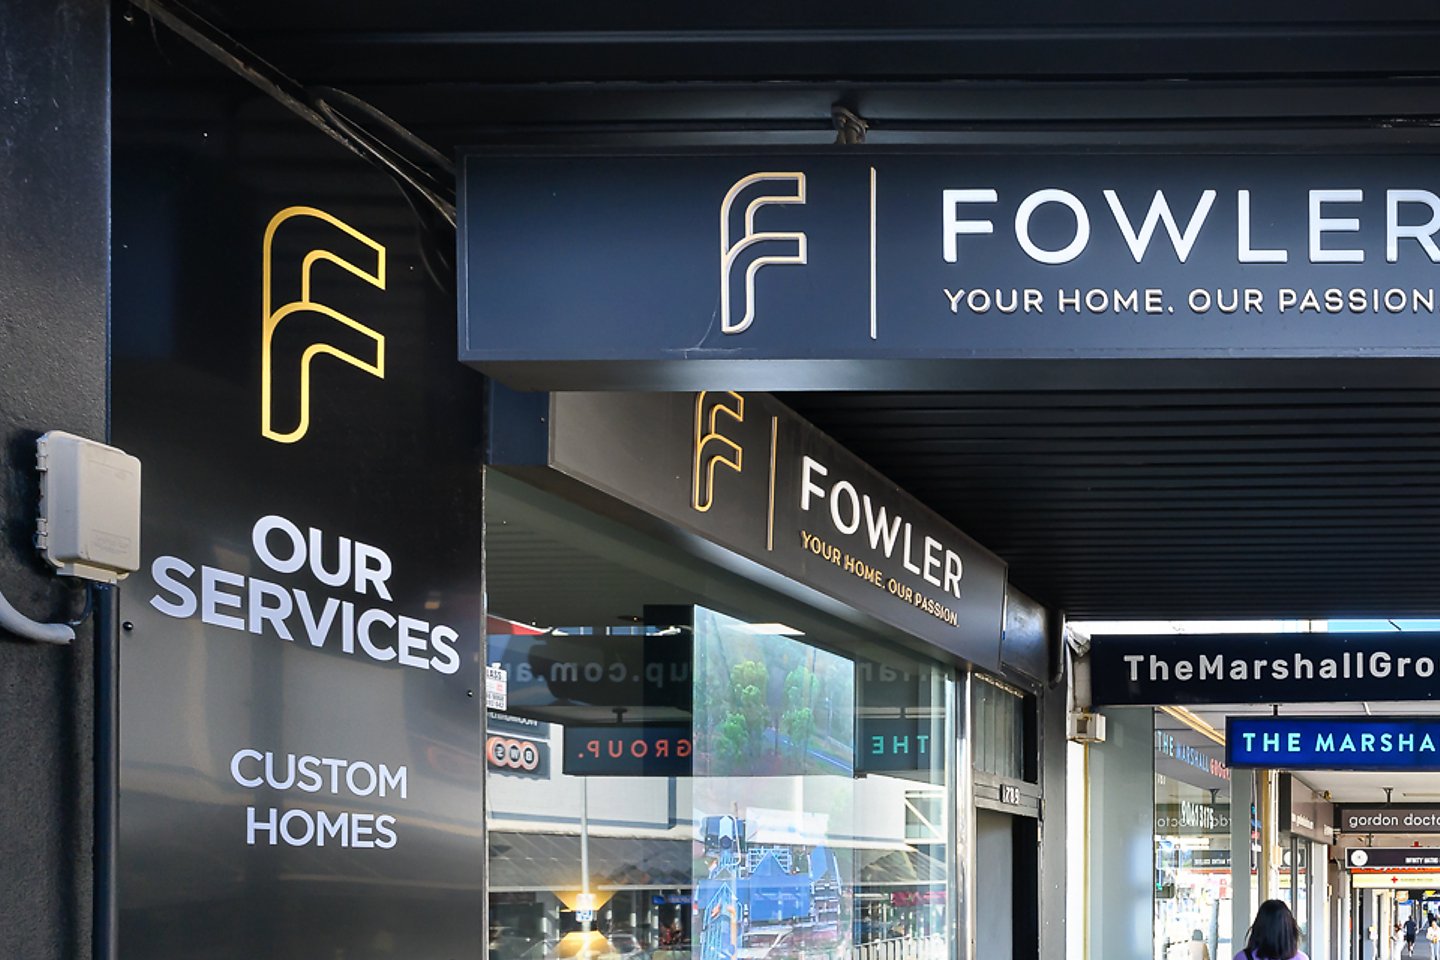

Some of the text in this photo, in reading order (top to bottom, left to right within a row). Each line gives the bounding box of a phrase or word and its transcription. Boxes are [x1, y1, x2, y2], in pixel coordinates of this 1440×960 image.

[943, 288, 1043, 313] YOUR
[1059, 288, 1174, 313] HOME.
[1188, 288, 1264, 313] OUR
[802, 457, 962, 598] FOWLER
[252, 515, 392, 601] OUR
[801, 530, 960, 629] YOUR HOME. OUR PASSION.
[150, 556, 460, 674] SERVICES
[1155, 730, 1174, 757] THE
[1243, 732, 1301, 752] THE
[230, 749, 408, 799] CUSTOM
[246, 807, 398, 850] HOMES
[1349, 813, 1399, 828] gordon
